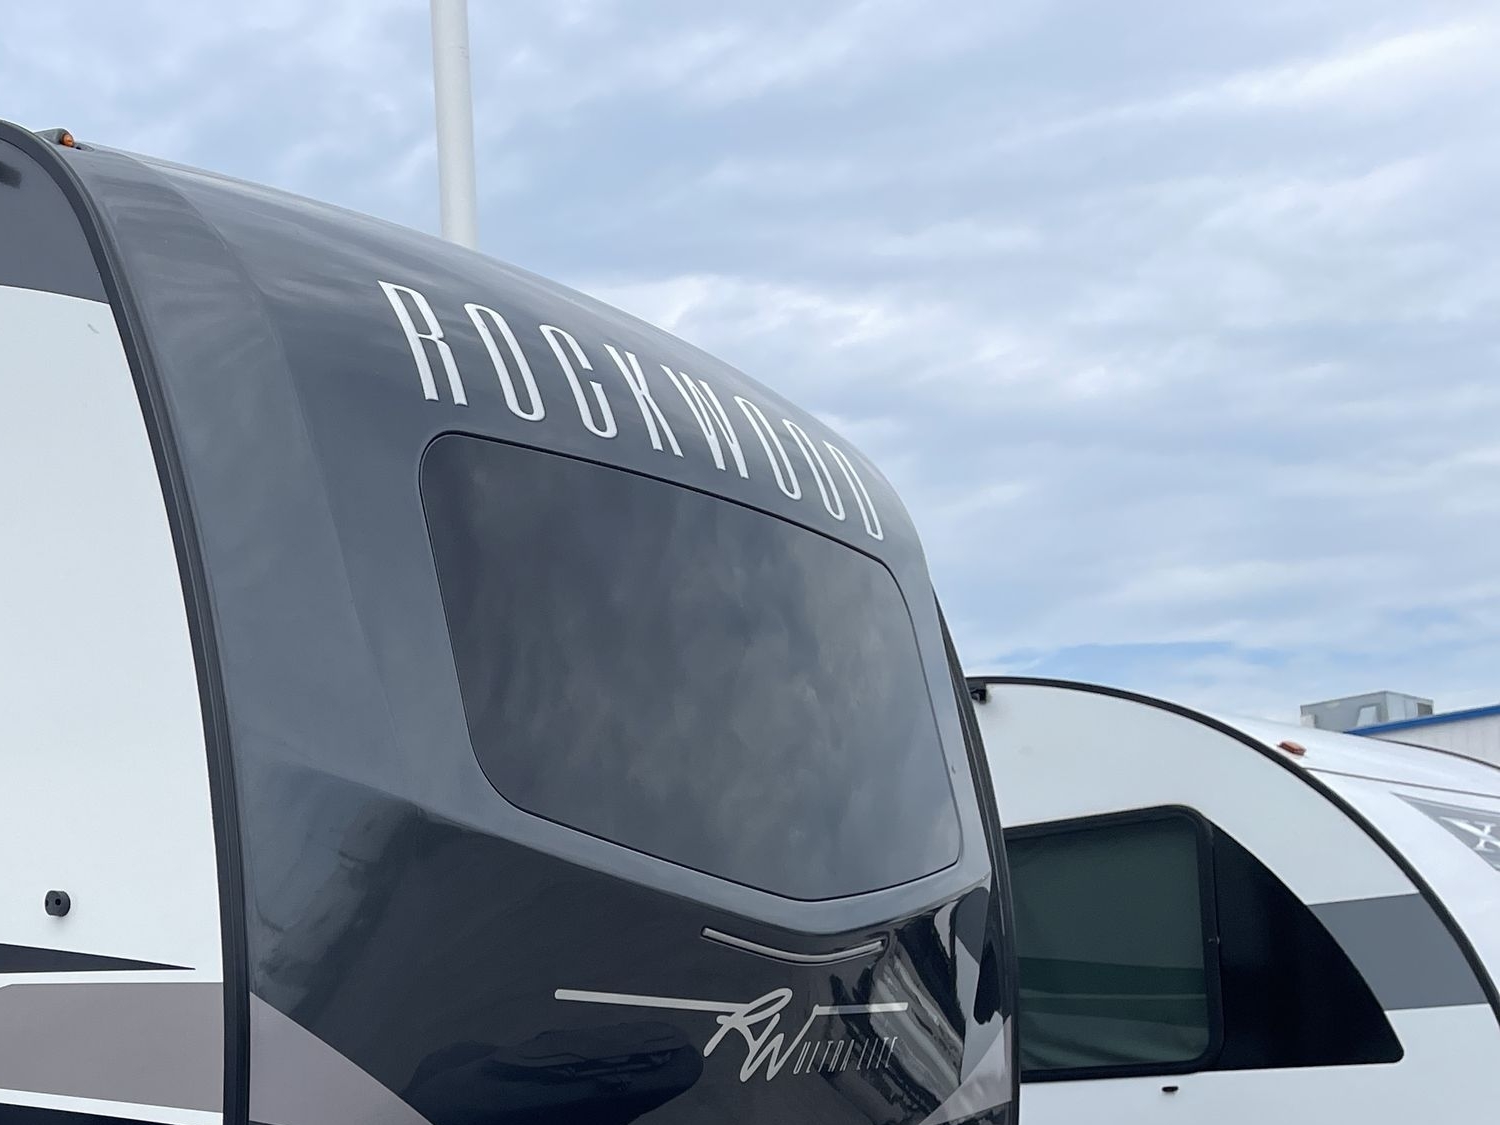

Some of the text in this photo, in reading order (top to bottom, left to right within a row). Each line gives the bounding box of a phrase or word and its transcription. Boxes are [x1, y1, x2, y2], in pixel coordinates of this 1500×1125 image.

[377, 279, 885, 541] ROCKWOOD
[793, 1039, 855, 1074] ULTRA
[856, 1036, 898, 1070] LITE
